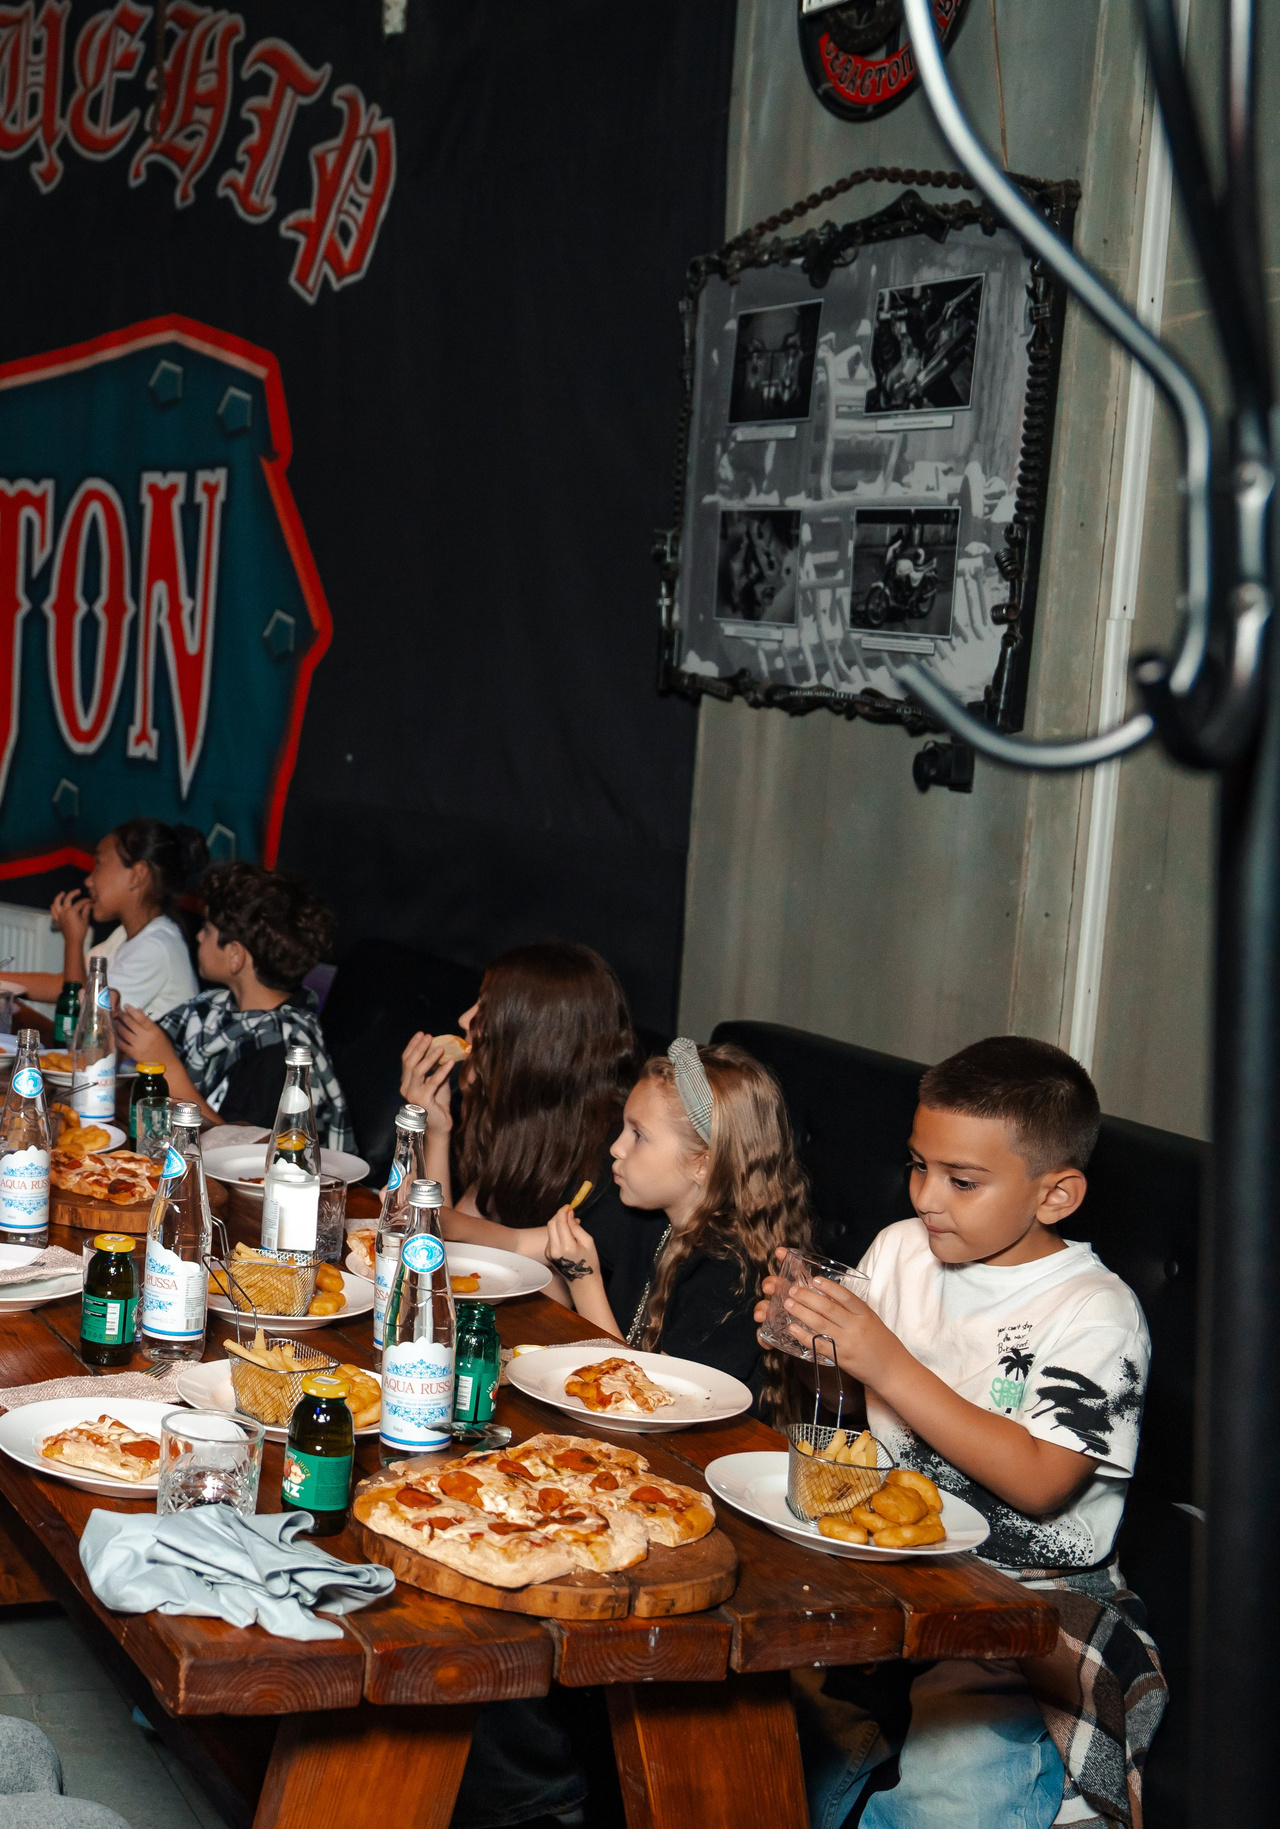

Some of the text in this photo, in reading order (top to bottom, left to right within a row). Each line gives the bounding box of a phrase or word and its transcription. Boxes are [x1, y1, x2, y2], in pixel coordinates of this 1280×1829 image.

[823, 40, 915, 98] СЕВАСТОП
[0, 1178, 27, 1190] AQUA
[146, 1274, 179, 1291] RUSSA
[384, 1376, 414, 1394] AQUA
